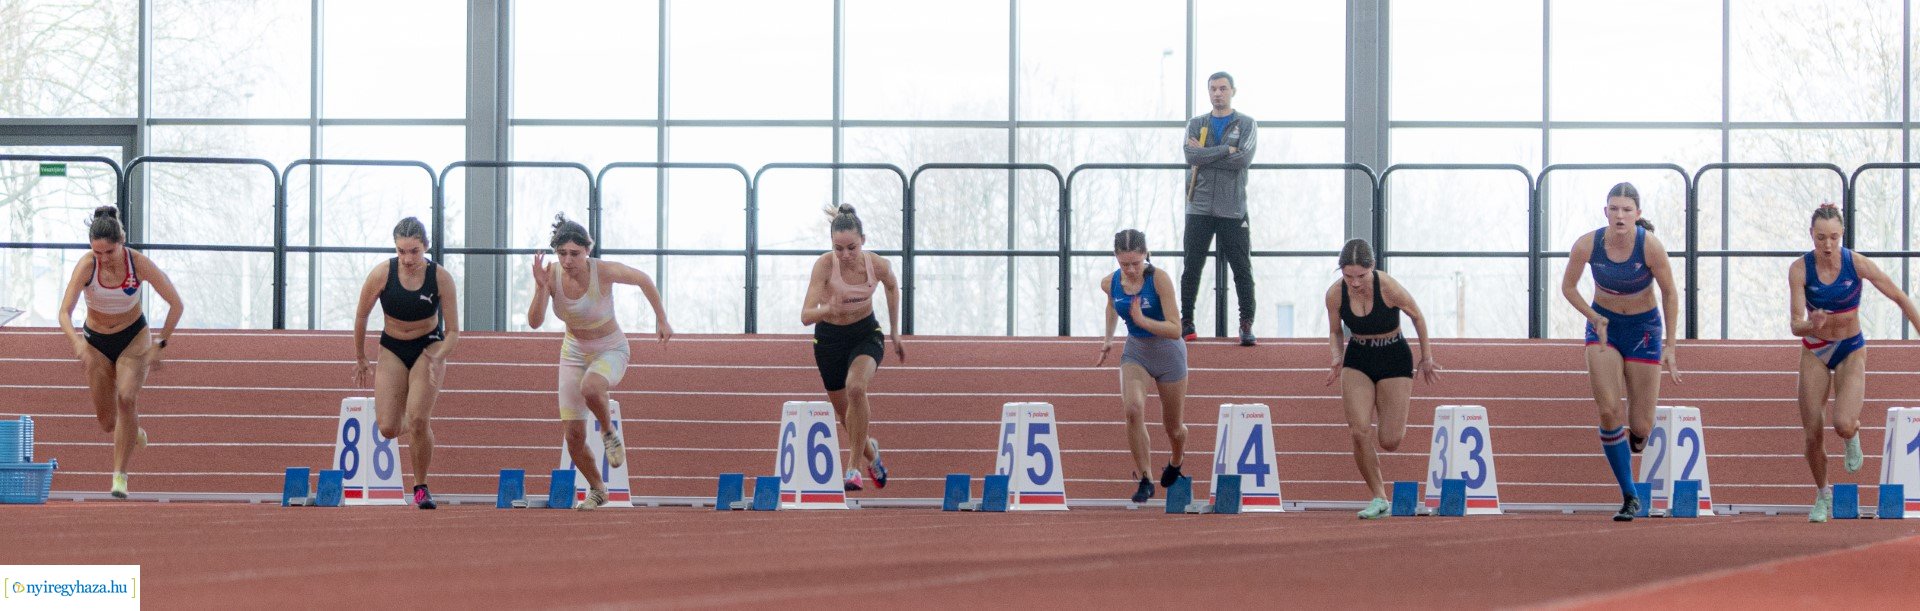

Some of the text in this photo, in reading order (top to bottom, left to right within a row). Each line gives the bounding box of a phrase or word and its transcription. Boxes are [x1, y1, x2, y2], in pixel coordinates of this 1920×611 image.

[340, 417, 361, 480] 8
[372, 420, 395, 480] 8
[781, 421, 797, 484] 6
[807, 421, 834, 485] 6
[1000, 422, 1016, 479] 5
[1026, 422, 1054, 485] 5
[1215, 423, 1227, 475] 4
[1237, 424, 1270, 487] 4
[1432, 426, 1449, 489] 3
[1460, 426, 1487, 489] 3
[1646, 426, 1667, 490] 2
[1677, 427, 1702, 490] 2
